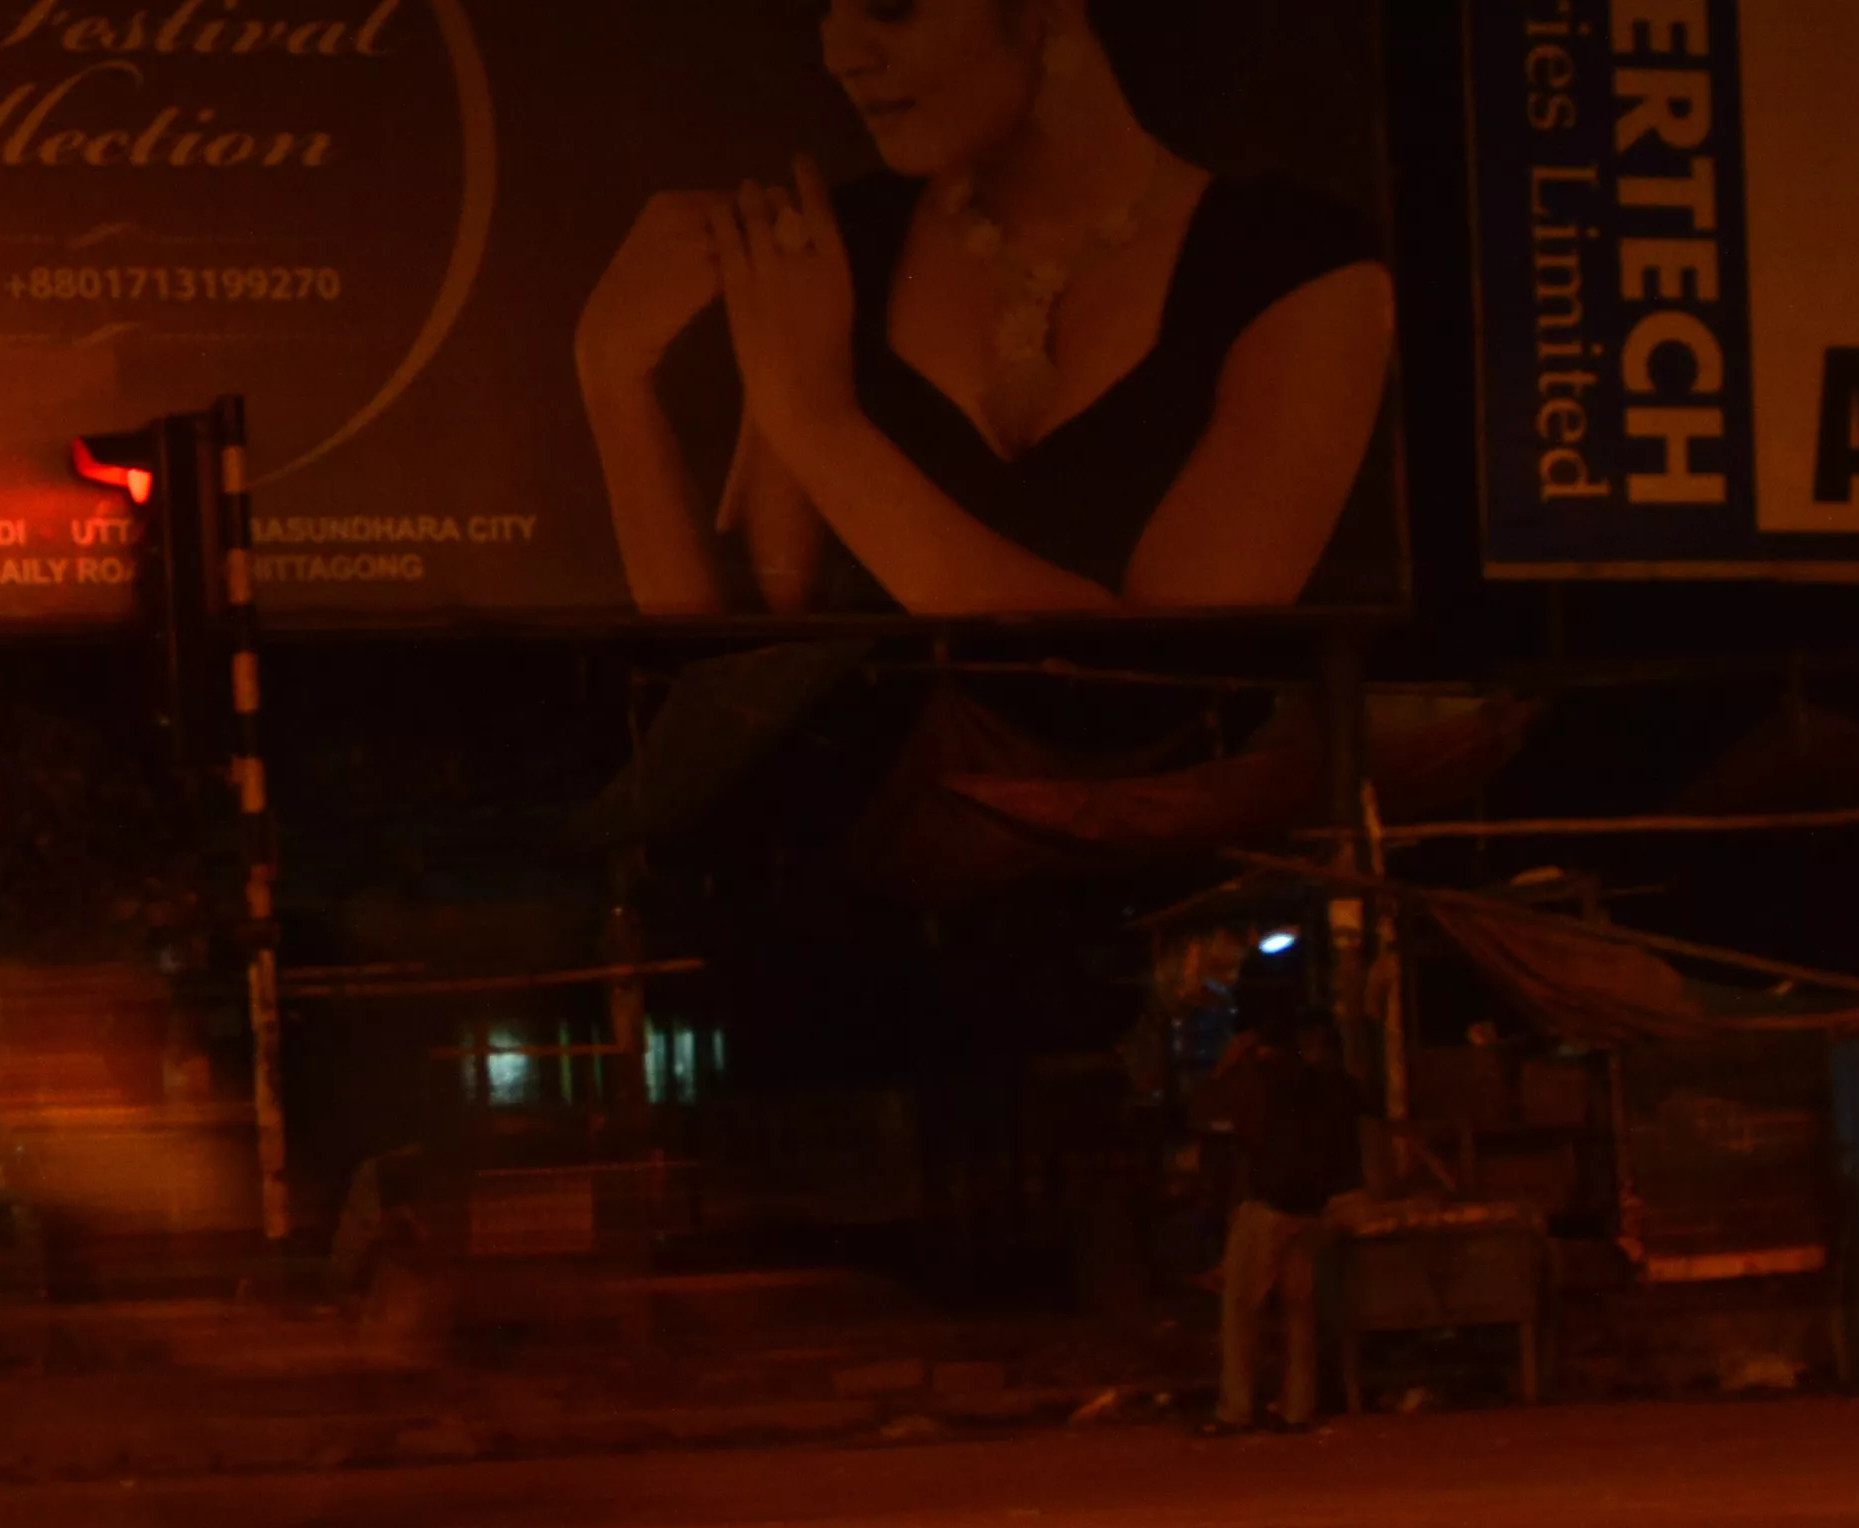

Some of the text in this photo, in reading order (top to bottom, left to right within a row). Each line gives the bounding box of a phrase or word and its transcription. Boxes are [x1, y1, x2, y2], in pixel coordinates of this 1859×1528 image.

[8, 265, 342, 302] +8801713199270
[1527, 160, 1612, 502] Limited
[71, 517, 138, 547] UTT
[470, 513, 539, 541] CITY
[252, 552, 426, 583] ITTAGONG
